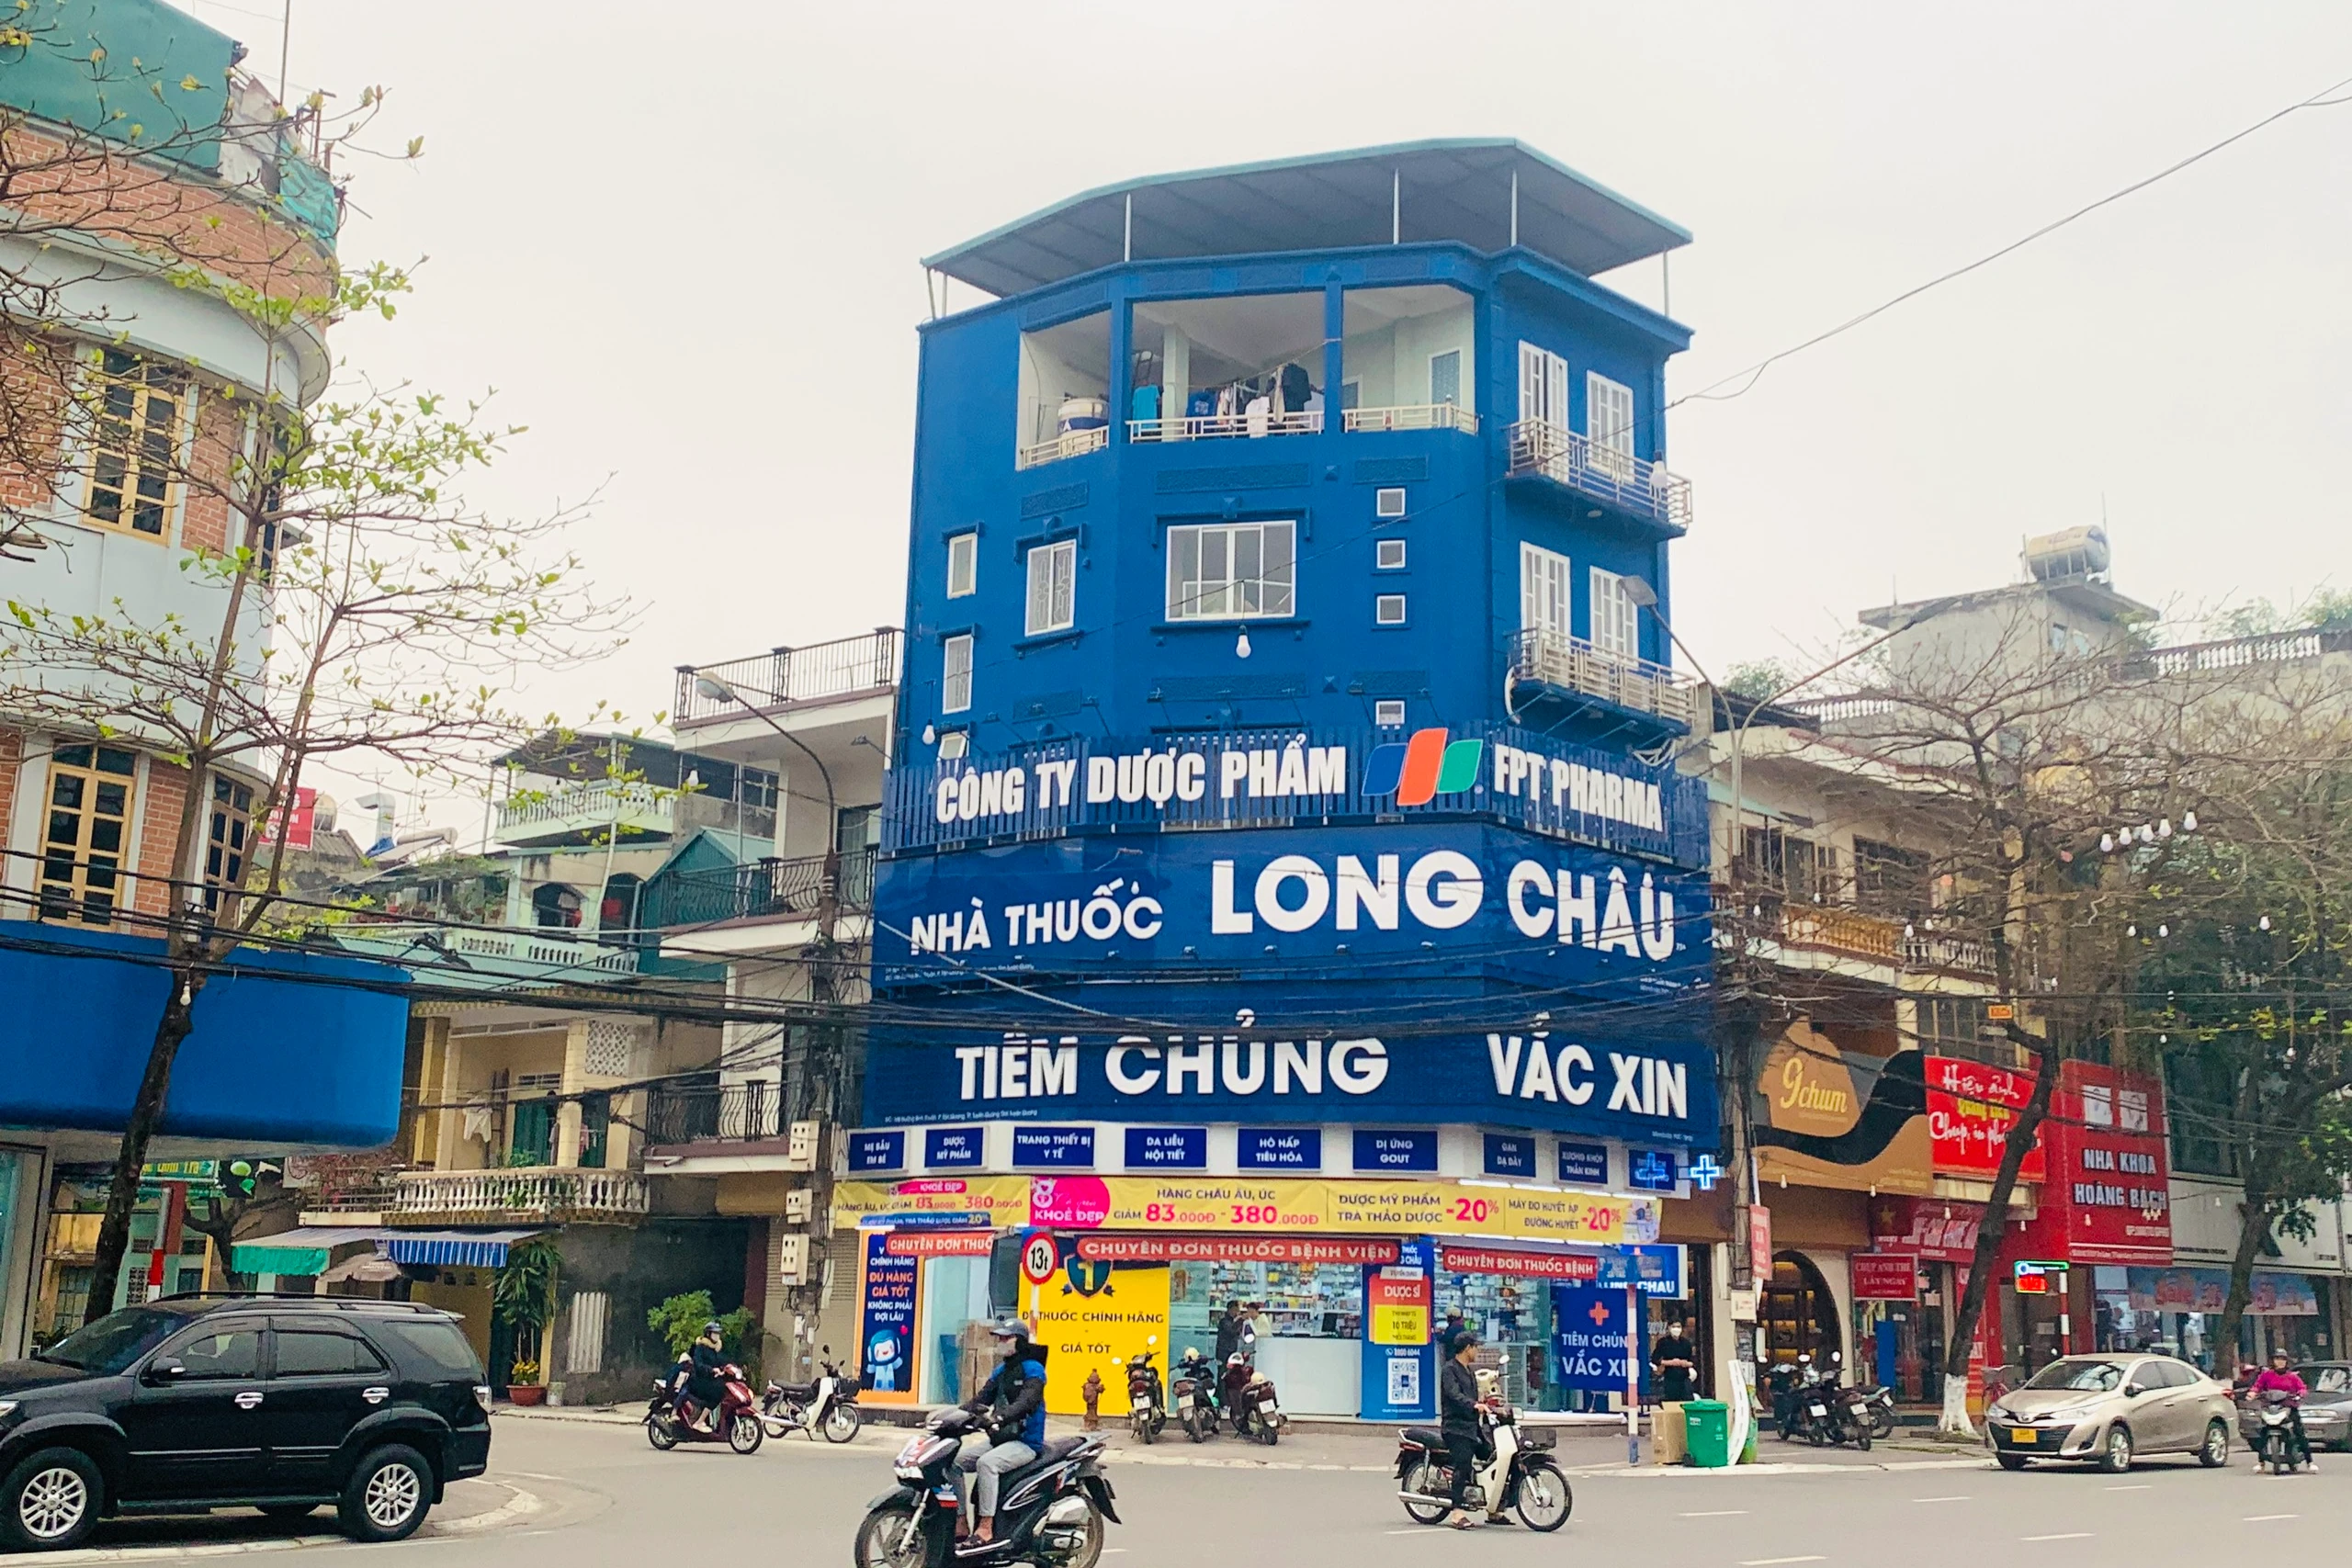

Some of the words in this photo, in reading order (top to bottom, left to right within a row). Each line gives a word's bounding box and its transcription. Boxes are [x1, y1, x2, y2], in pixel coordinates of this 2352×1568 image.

[937, 767, 1024, 823] CÔNG
[1035, 758, 1076, 808] TY
[1087, 748, 1204, 809] DƯỢC
[1221, 733, 1346, 797] PHẨM
[1494, 742, 1545, 801] FPT
[1552, 758, 1664, 832] PHARMA
[911, 897, 990, 954] NHÀ
[1005, 877, 1162, 946] THUỐC
[1212, 850, 1484, 934] LONG
[1507, 859, 1675, 961] CHÂU
[955, 1032, 1079, 1100] TIÊM
[1105, 1009, 1390, 1096] CHỦNG
[1487, 1011, 1595, 1105] VẮC
[1607, 1053, 1688, 1120] XIN
[943, 1136, 966, 1147] DƯỢC
[1017, 1135, 1050, 1145] TRANG
[1053, 1133, 1080, 1145] THIẾT
[1081, 1136, 1091, 1147] BỊ
[1147, 1136, 1161, 1146] DA
[1259, 1136, 1275, 1148] HÔ
[1278, 1134, 1300, 1148] HẤP
[1376, 1140, 1387, 1152] DỊ
[1390, 1137, 1413, 1149] ỨNG
[1044, 1149, 1051, 1158] Y
[1052, 1146, 1065, 1159] TẾ
[1145, 1150, 1164, 1163] NỘI
[1167, 1147, 1185, 1160] TIẾT
[1256, 1150, 1276, 1163] TIÊU
[1279, 1149, 1303, 1163] HÓA
[1380, 1154, 1410, 1165] GOUT
[2084, 1149, 2114, 1170] NHA
[2120, 1152, 2157, 1175] KHOA
[1157, 1186, 1193, 1200] HÀNG
[1196, 1187, 1231, 1200] CHÂU
[1259, 1186, 1275, 1200] ÚC
[1339, 1194, 1375, 1207] DƯỢC
[1380, 1193, 1398, 1205] MỸ
[1402, 1192, 1441, 1206] PHẨM
[1509, 1198, 1526, 1210] MÁY
[1528, 1201, 1541, 1211] ĐO
[1543, 1201, 1566, 1213] HUYẾT
[1567, 1202, 1578, 1213] ÁP
[1114, 1207, 1141, 1220] GIẢM
[1338, 1210, 1362, 1222] TRÀ
[1366, 1208, 1401, 1223] THẢO
[1406, 1212, 1442, 1224] DƯỢC
[1524, 1216, 1553, 1229] ĐƯỜNG
[1555, 1218, 1578, 1230] HUYẾT
[890, 1236, 933, 1251] CHUYÊN
[936, 1237, 961, 1250] ĐƠN
[964, 1235, 993, 1250] THUỐ
[1085, 1240, 1164, 1256] CHUYÊN
[1169, 1241, 1212, 1256] ĐƠN
[1217, 1240, 1284, 1257] THUỐC
[1291, 1243, 1341, 1261] BỆNH
[1347, 1243, 1392, 1262] VIỆN
[870, 1256, 892, 1267] CHÍNH
[1031, 1247, 1048, 1271] 13t
[1448, 1254, 1494, 1268] CHUYÊN
[1497, 1258, 1522, 1269] ĐƠN
[1524, 1258, 1562, 1273] THUỐC
[1566, 1260, 1594, 1275] BỆNH
[869, 1269, 884, 1282] ĐỦ
[886, 1269, 914, 1282] HÀNG
[872, 1285, 888, 1297] GIÁ
[890, 1282, 910, 1297] TỐT
[1385, 1286, 1412, 1300] DƯỢC
[867, 1300, 893, 1310] KHÔNG
[895, 1299, 912, 1310] PHẢI
[875, 1312, 888, 1323] ĐỢI
[889, 1311, 904, 1321] LÂU
[1082, 1310, 1123, 1323] CHÍNH
[1127, 1311, 1163, 1324] HÃNG
[1562, 1330, 1589, 1347] TIÊM
[1592, 1331, 1638, 1348] CHỦN
[1061, 1341, 1082, 1353] GIÁ
[1562, 1348, 1602, 1376] VẮC
[1608, 1358, 1639, 1377] XI
